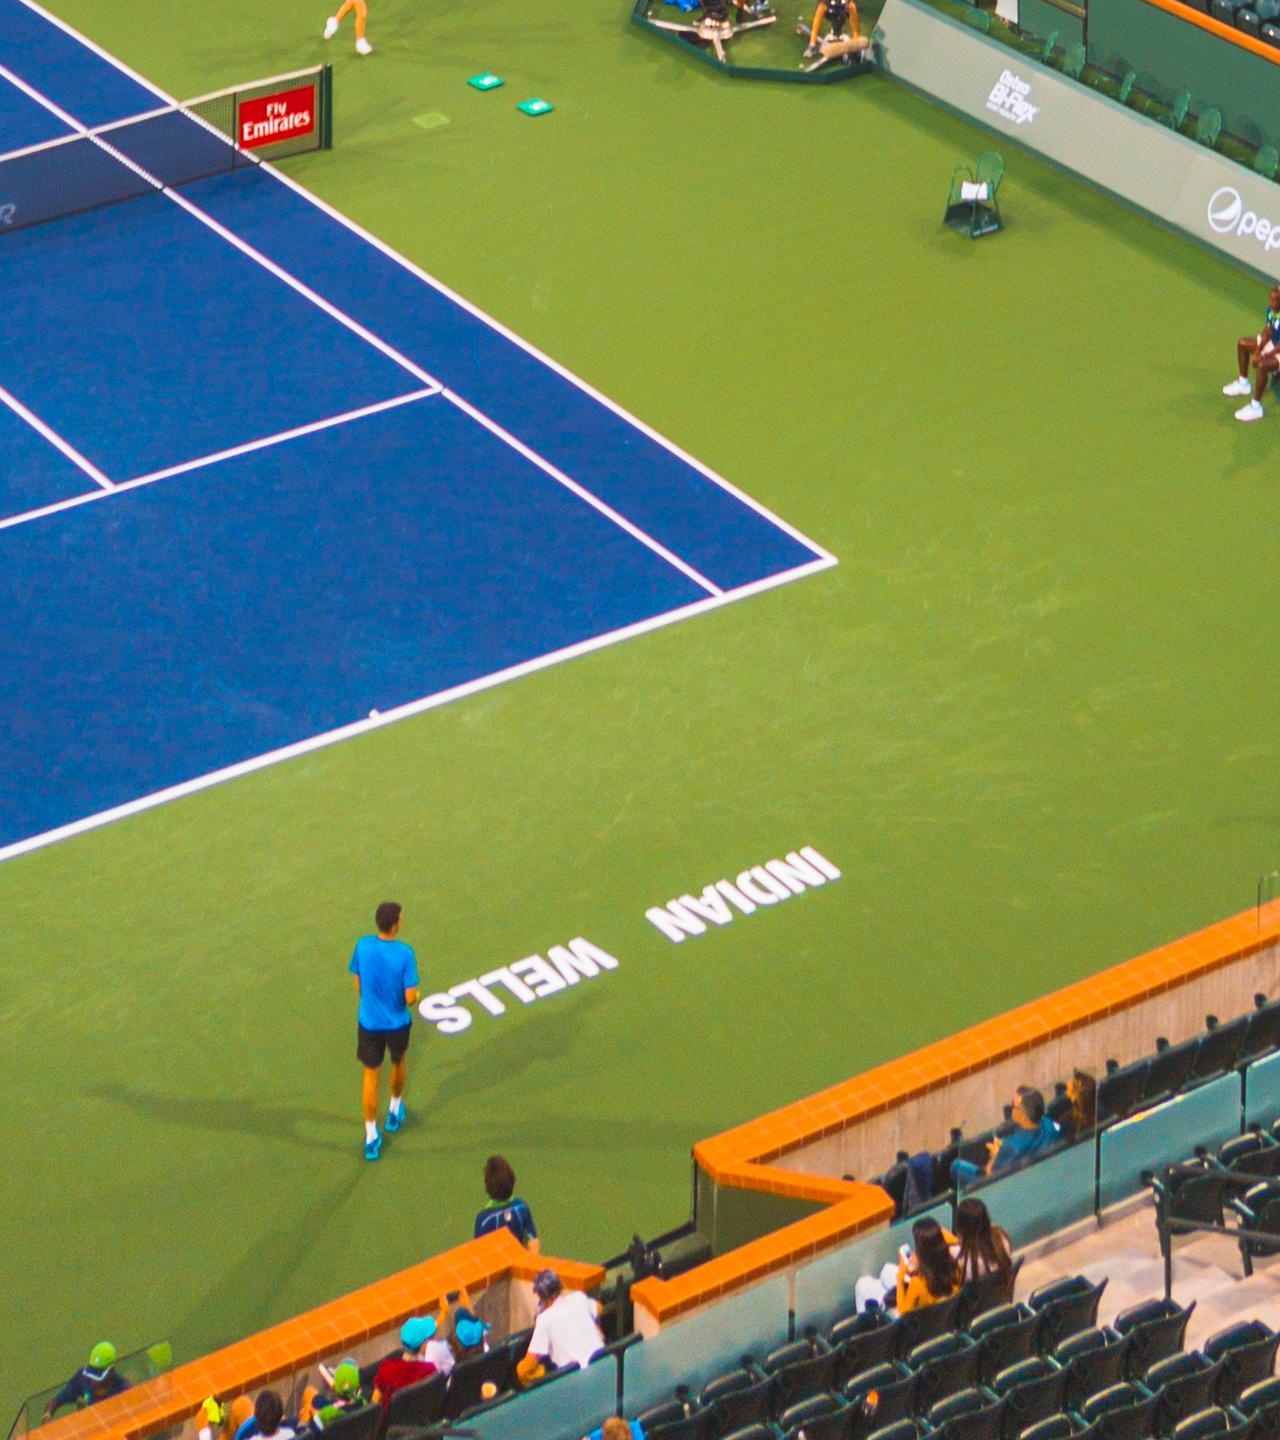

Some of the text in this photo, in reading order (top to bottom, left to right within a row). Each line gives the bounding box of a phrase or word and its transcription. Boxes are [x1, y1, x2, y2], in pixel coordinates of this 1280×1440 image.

[266, 101, 287, 116] Fly
[243, 109, 311, 142] Emirates
[419, 845, 841, 1034] INDIAN WELLS
